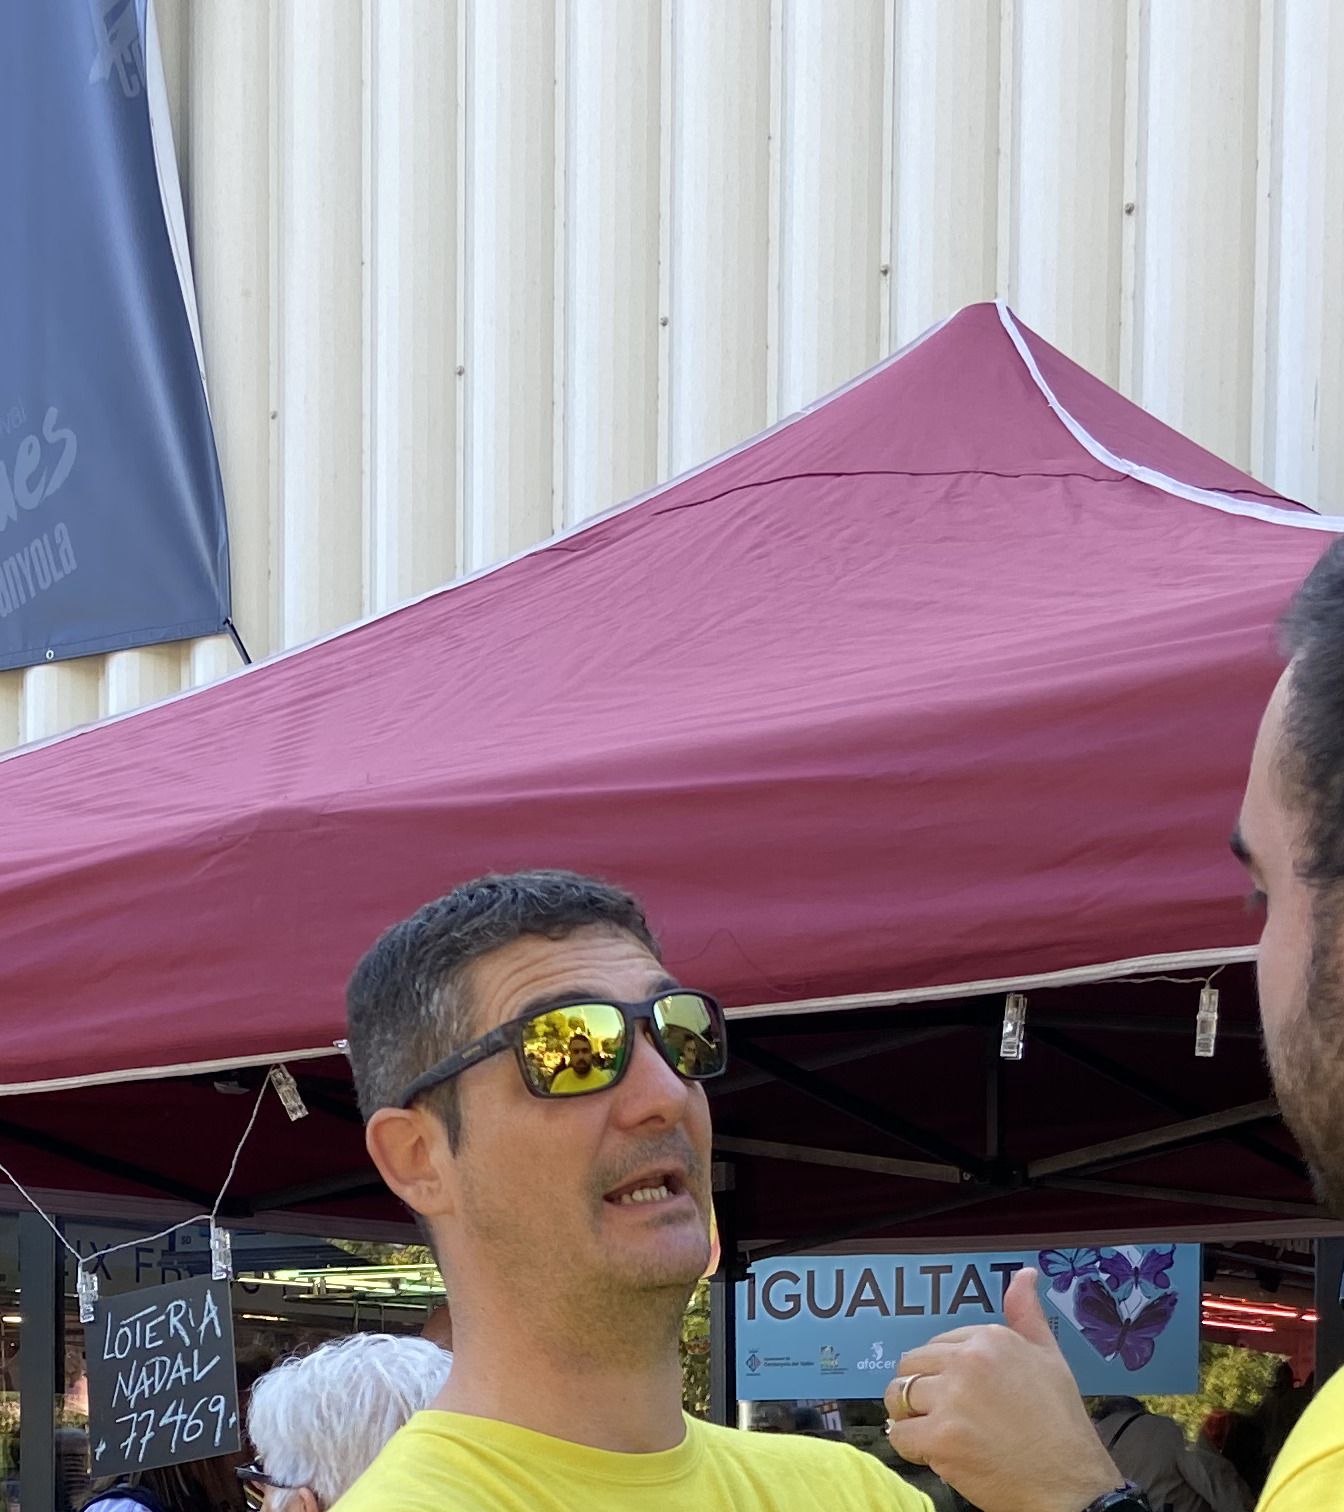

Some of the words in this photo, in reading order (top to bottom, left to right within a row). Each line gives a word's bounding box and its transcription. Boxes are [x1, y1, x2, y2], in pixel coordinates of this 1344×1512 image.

[111, 1349, 221, 1409] NADAL
[856, 1358, 897, 1371] afocer
[115, 1395, 226, 1463] 77469
